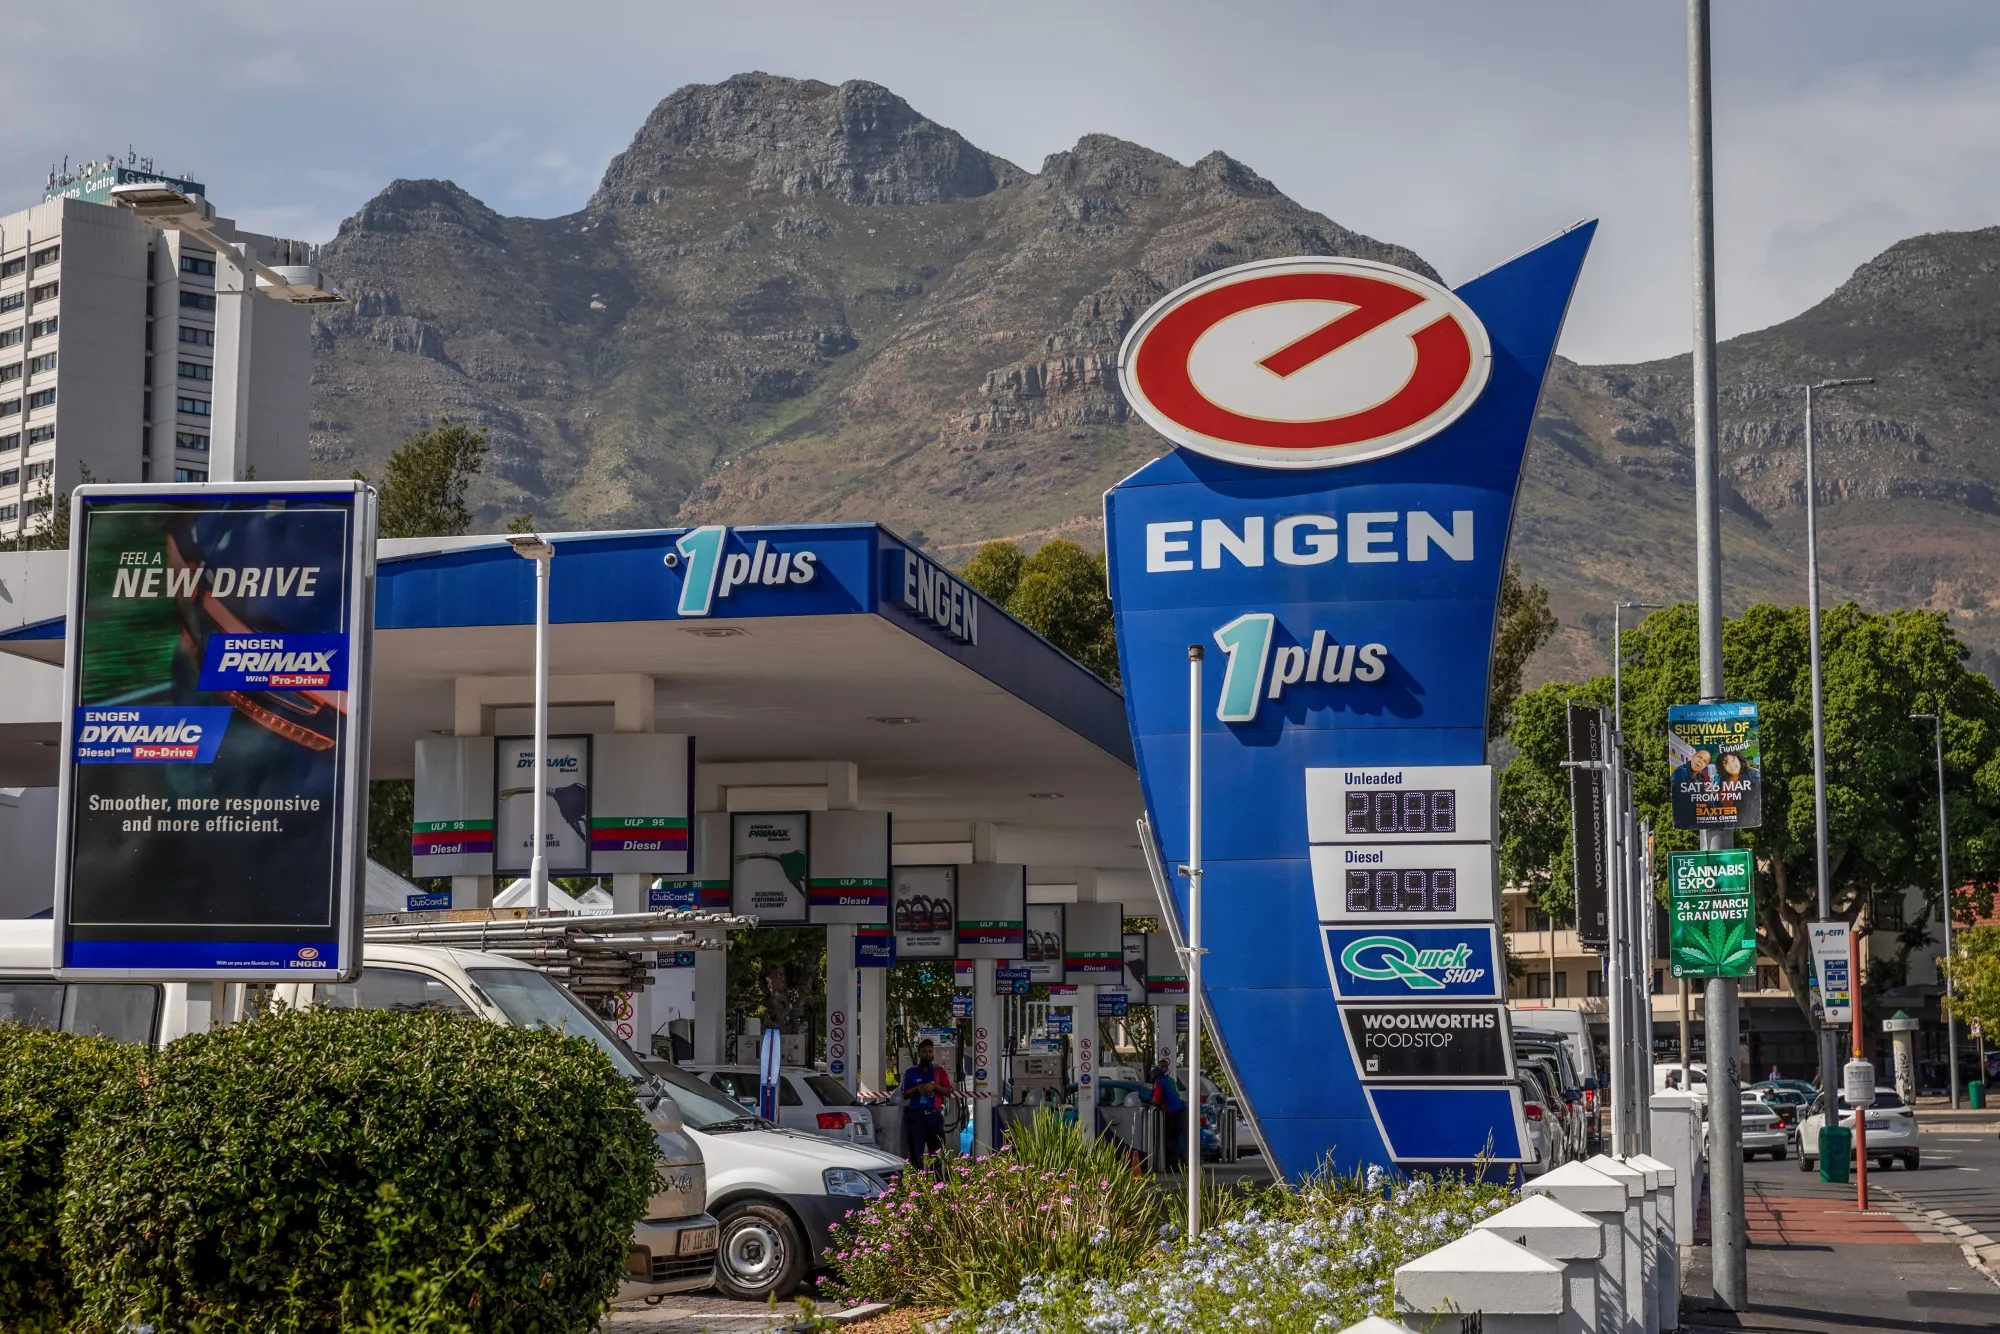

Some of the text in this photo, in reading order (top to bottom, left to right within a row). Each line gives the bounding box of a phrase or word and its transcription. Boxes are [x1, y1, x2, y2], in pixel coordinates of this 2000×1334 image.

[85, 175, 115, 193] Centre
[1146, 510, 1474, 573] ENGEN
[120, 552, 162, 565] FEEL A
[112, 567, 320, 598] NEW DRIVE
[904, 547, 978, 646] ENGEN
[224, 639, 284, 650] ENGEN
[218, 649, 339, 672] PRIMAX
[245, 675, 325, 685] With Pro-Drive
[85, 712, 140, 722] ENGEN
[78, 717, 202, 743] DYNAMIC
[1675, 722, 1750, 735] SURVIVAL OF
[1681, 735, 1701, 744] THE
[78, 748, 115, 757] Diesel
[135, 748, 194, 757] Pro-Drive
[517, 756, 578, 768] DYAMIC
[1345, 772, 1402, 785] Unleaded
[1680, 780, 1751, 792] SAT 26 MAR
[1691, 792, 1742, 802] FROM 7PM
[89, 795, 320, 814] Smoother, more responsive
[1589, 719, 1601, 888] WOOLWORTHS FODSTOP
[1347, 791, 1454, 833] 20.88
[1696, 807, 1738, 816] BAXTER
[122, 816, 283, 832] and more efficient.
[431, 821, 464, 831] ULP 95
[624, 819, 643, 827] ULP
[749, 829, 789, 838] PRIMAX
[430, 844, 461, 854] Diesel
[623, 841, 661, 850] Diesel
[1345, 850, 1383, 863] Diesel
[1678, 859, 1694, 867] THE
[1677, 864, 1745, 878] CANNABIS
[1678, 877, 1715, 889] EXPO
[411, 898, 442, 906] ClubCard
[651, 893, 687, 901] ClubCard
[839, 897, 870, 905] Diesel
[1677, 902, 1690, 910] 24
[1698, 901, 1709, 909] 27
[1712, 898, 1748, 909] MARCH
[1677, 909, 1748, 921] GRANDWEST
[1443, 968, 1484, 983] SHOP
[1362, 1014, 1495, 1029] WOOLWORTHS
